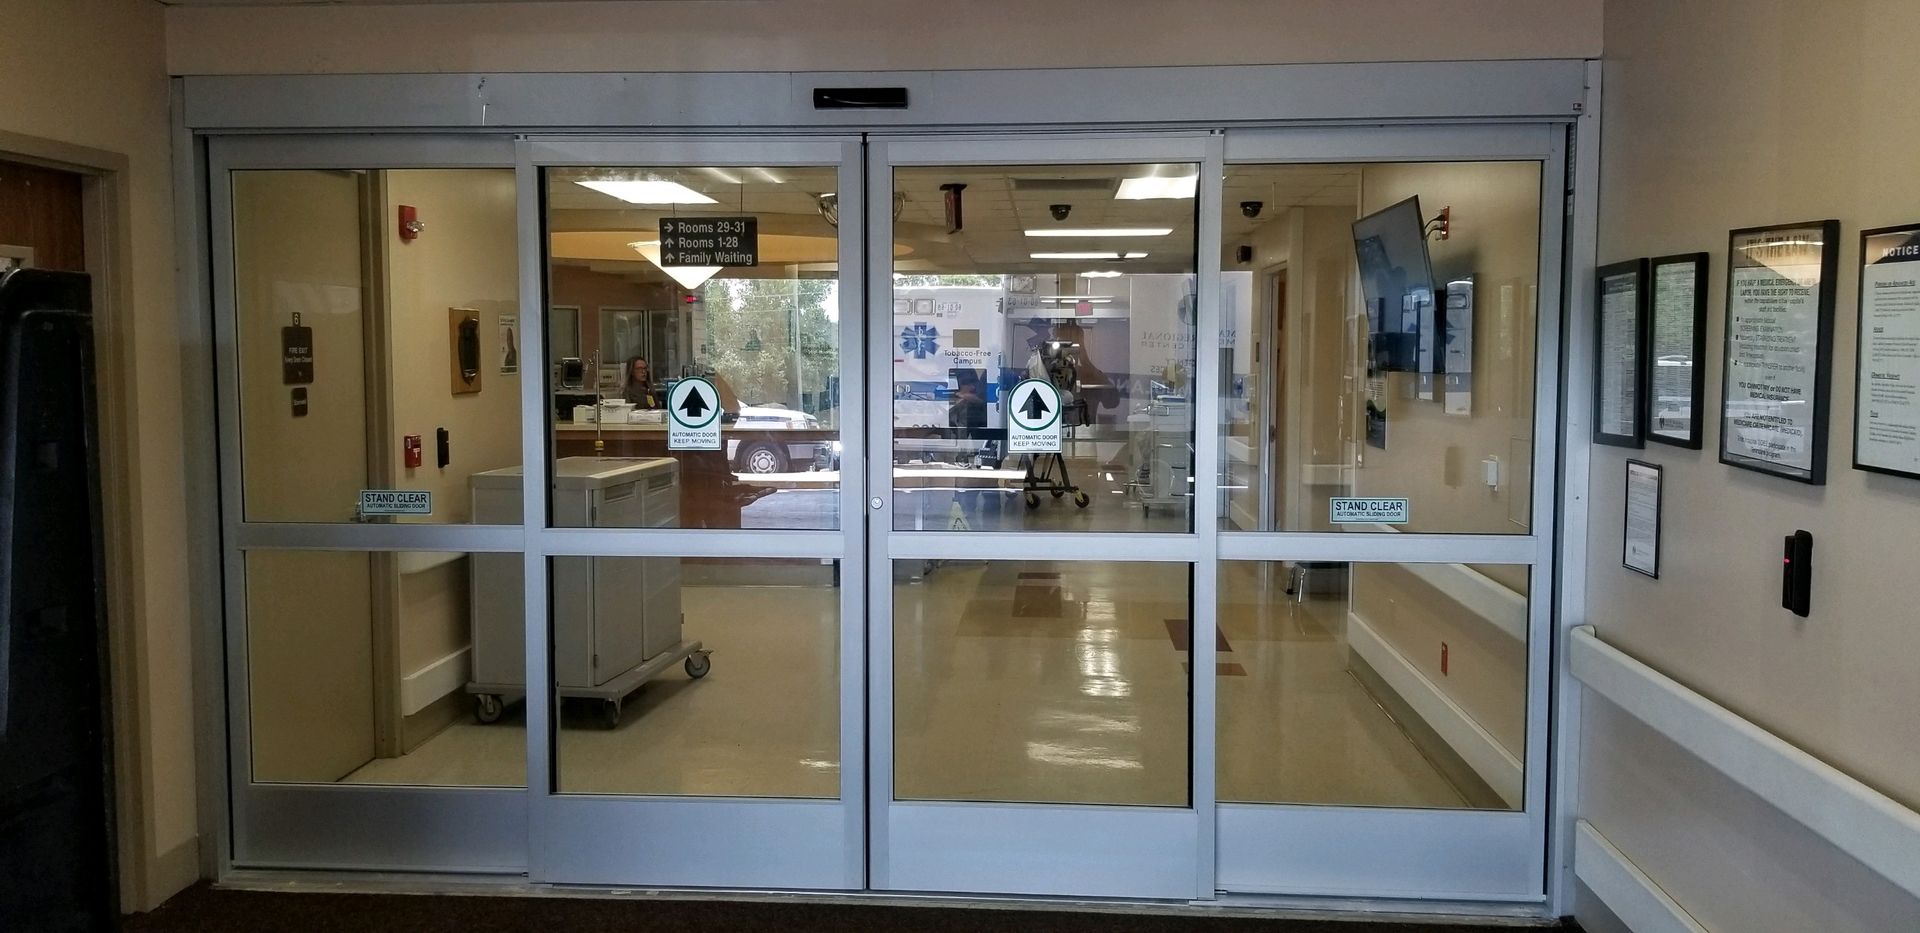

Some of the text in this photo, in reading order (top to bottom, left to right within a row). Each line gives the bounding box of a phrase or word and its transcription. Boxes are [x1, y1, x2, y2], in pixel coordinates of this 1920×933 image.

[678, 221, 745, 233] Rooms 29-31
[678, 236, 739, 248] Rooms 1-28
[1882, 245, 1919, 257] NOTICE
[679, 251, 753, 266] Family Waiting
[953, 357, 983, 365] Campus
[365, 493, 427, 503] STAND CLEAR
[1336, 502, 1403, 511] STAND CLEAR
